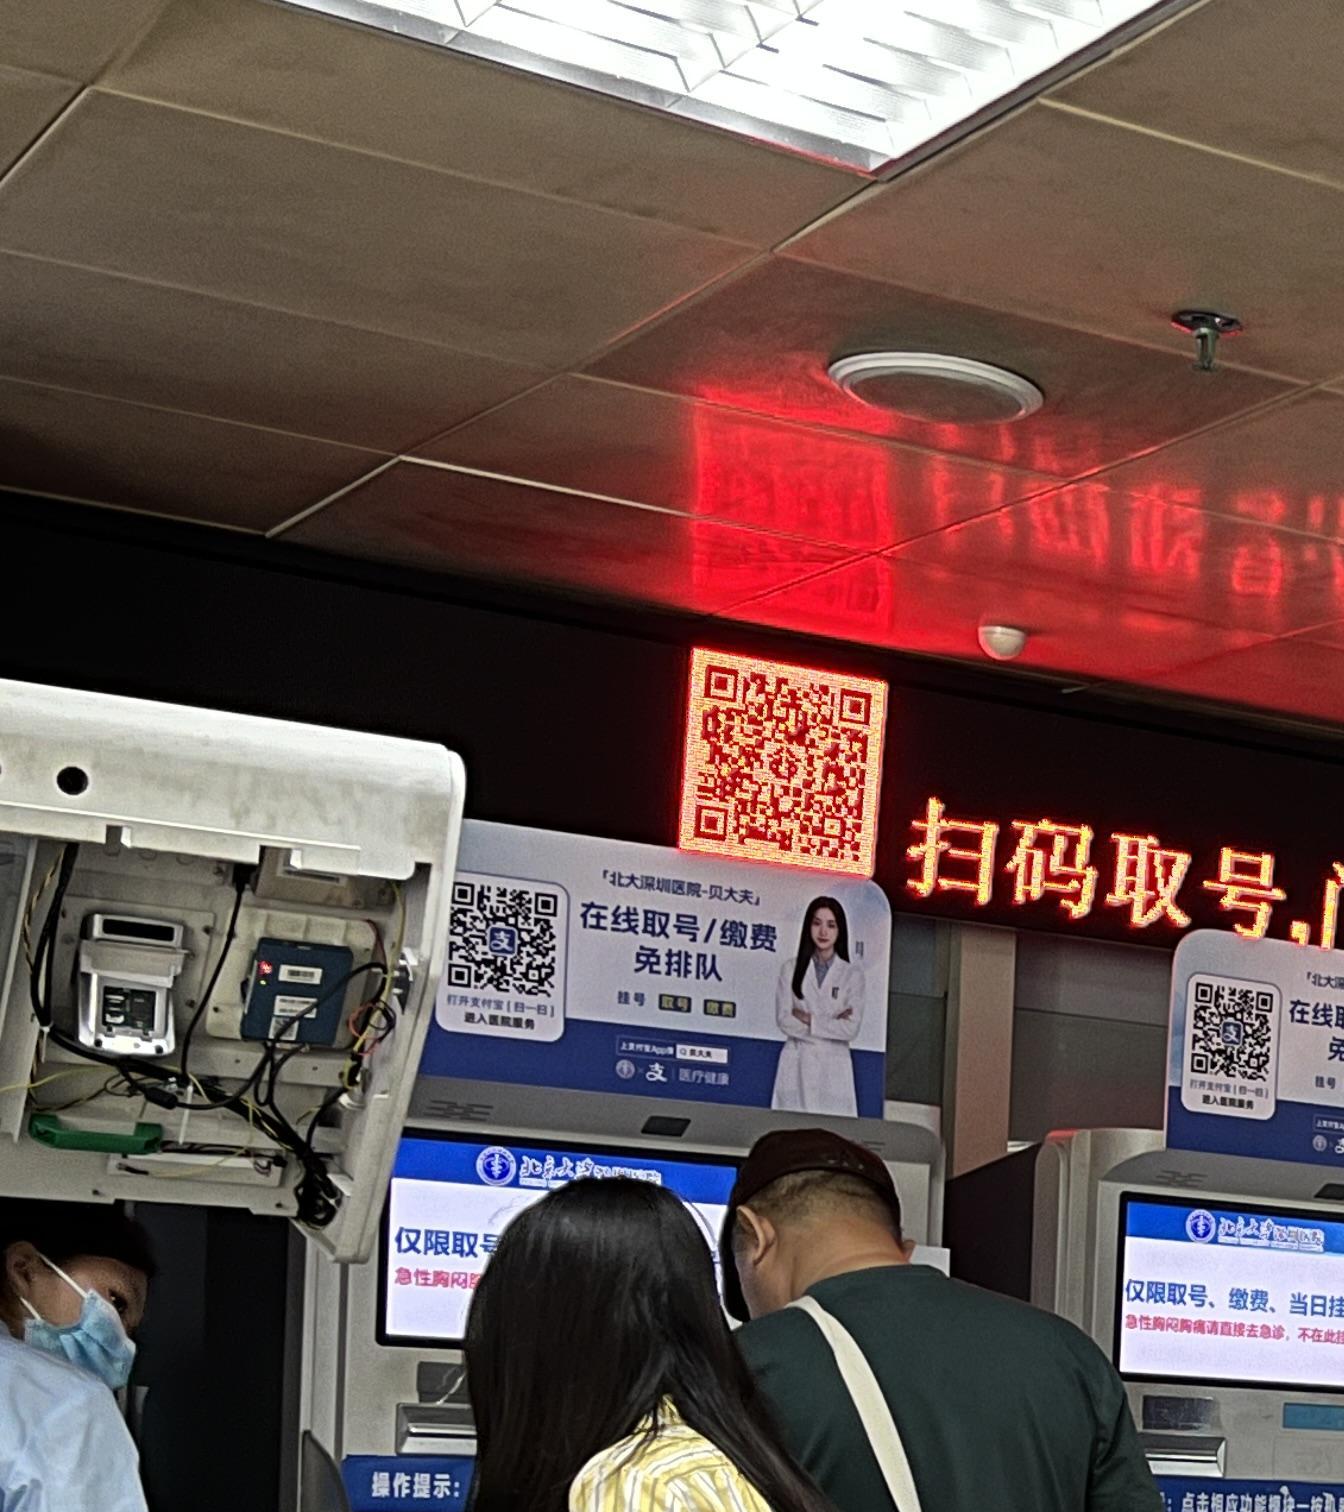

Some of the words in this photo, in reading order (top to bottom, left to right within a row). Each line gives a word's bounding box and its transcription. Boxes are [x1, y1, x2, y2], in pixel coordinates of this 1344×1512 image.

[580, 901, 778, 952] 在线取号/缴费
[634, 945, 723, 982] 免排队
[372, 1471, 460, 1498] 操作提示：
